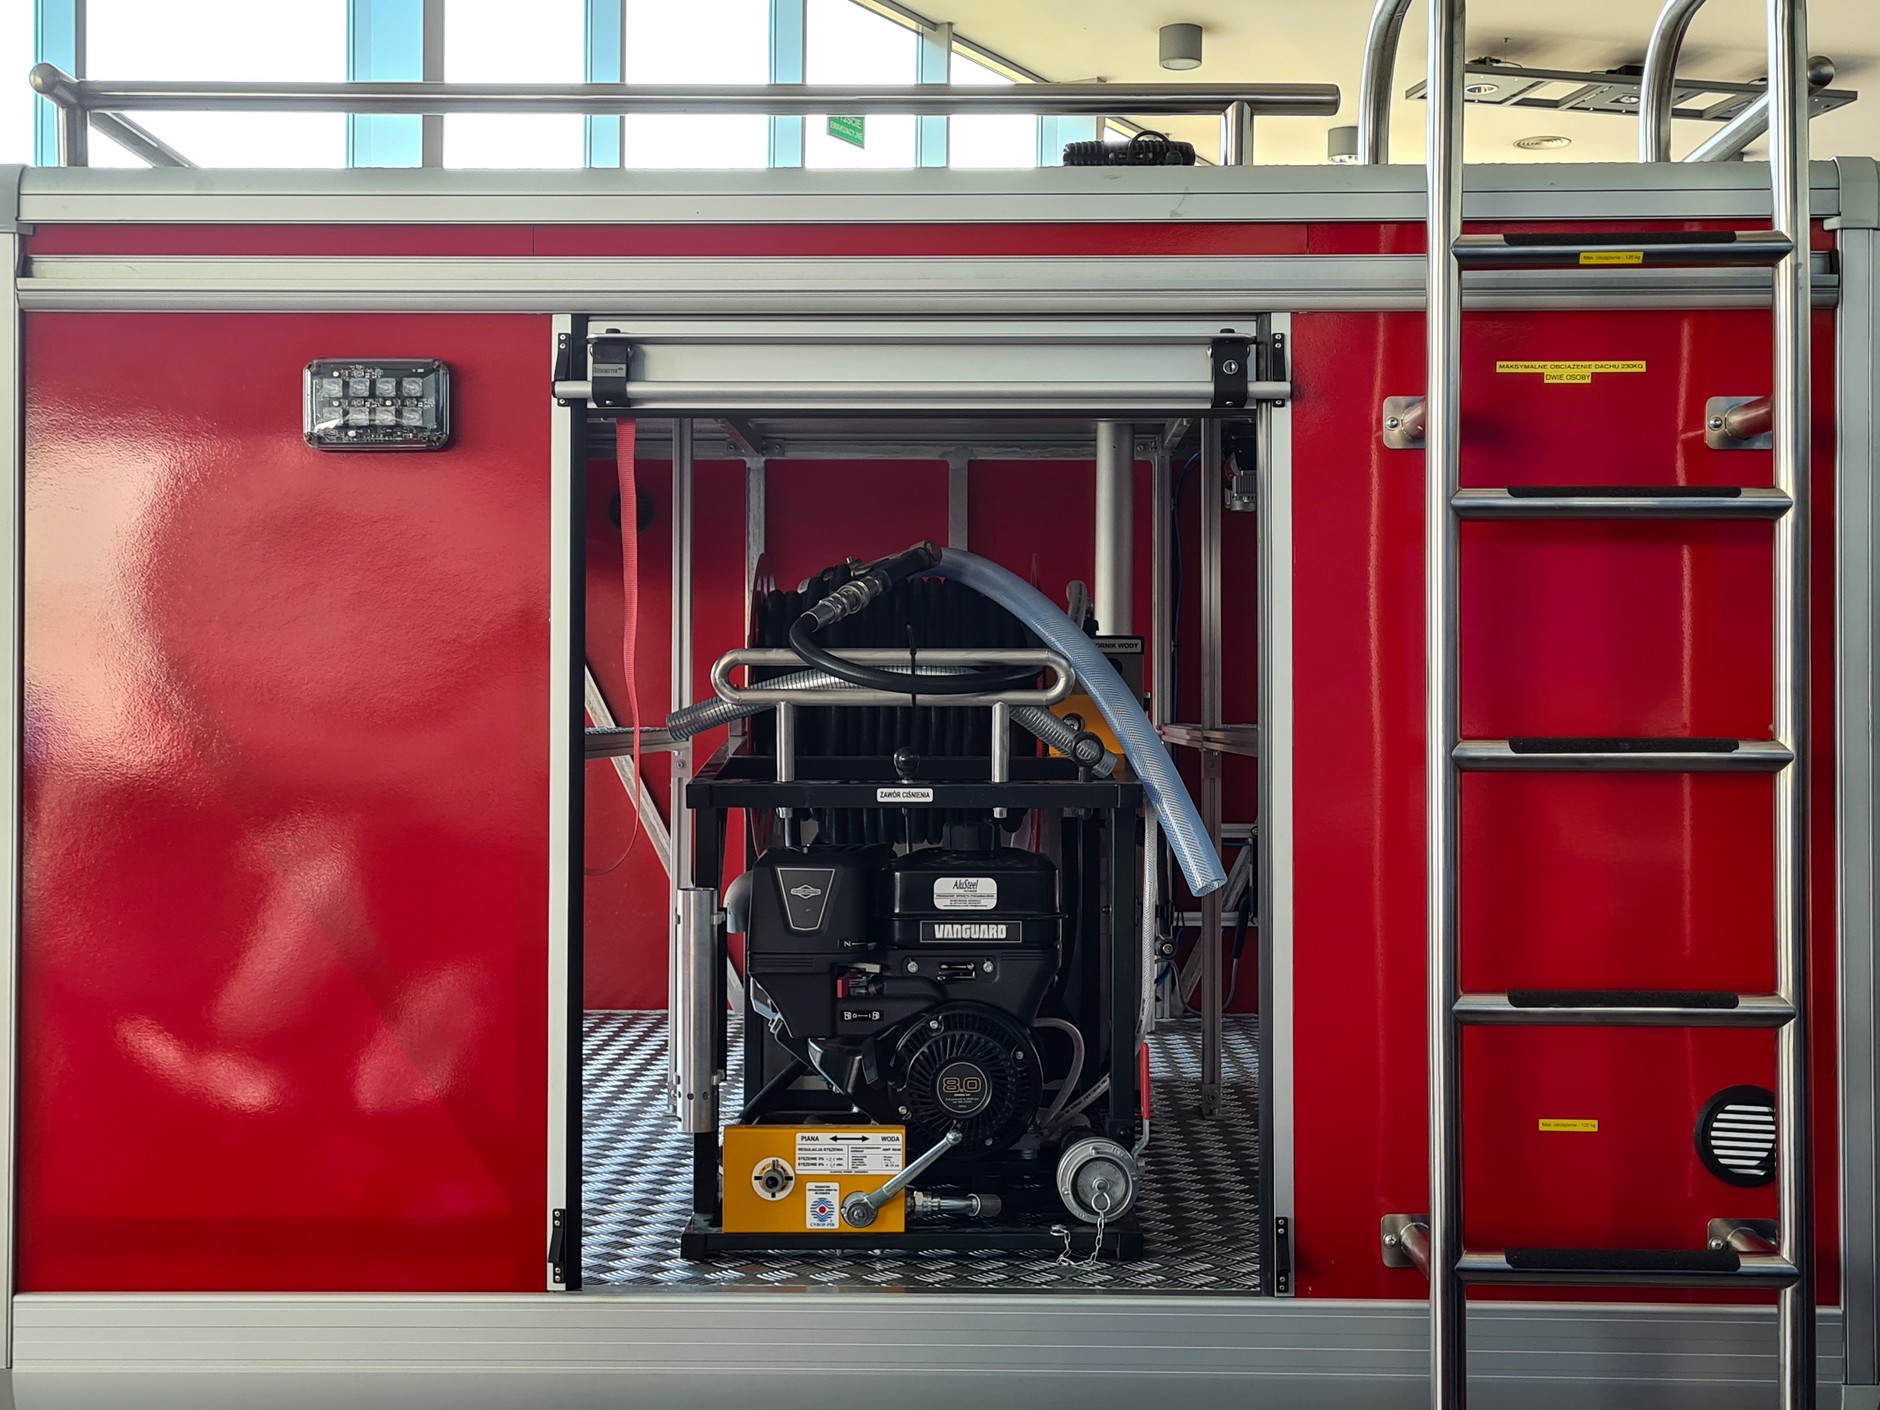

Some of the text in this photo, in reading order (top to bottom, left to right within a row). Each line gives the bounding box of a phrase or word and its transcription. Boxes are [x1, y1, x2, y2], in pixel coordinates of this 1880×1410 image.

[880, 790, 930, 799] ZAWÓR CIŚNIENIA
[952, 879, 979, 890] AluSteel
[934, 924, 1007, 939] VANGUARD
[943, 1077, 981, 1093] 8.0
